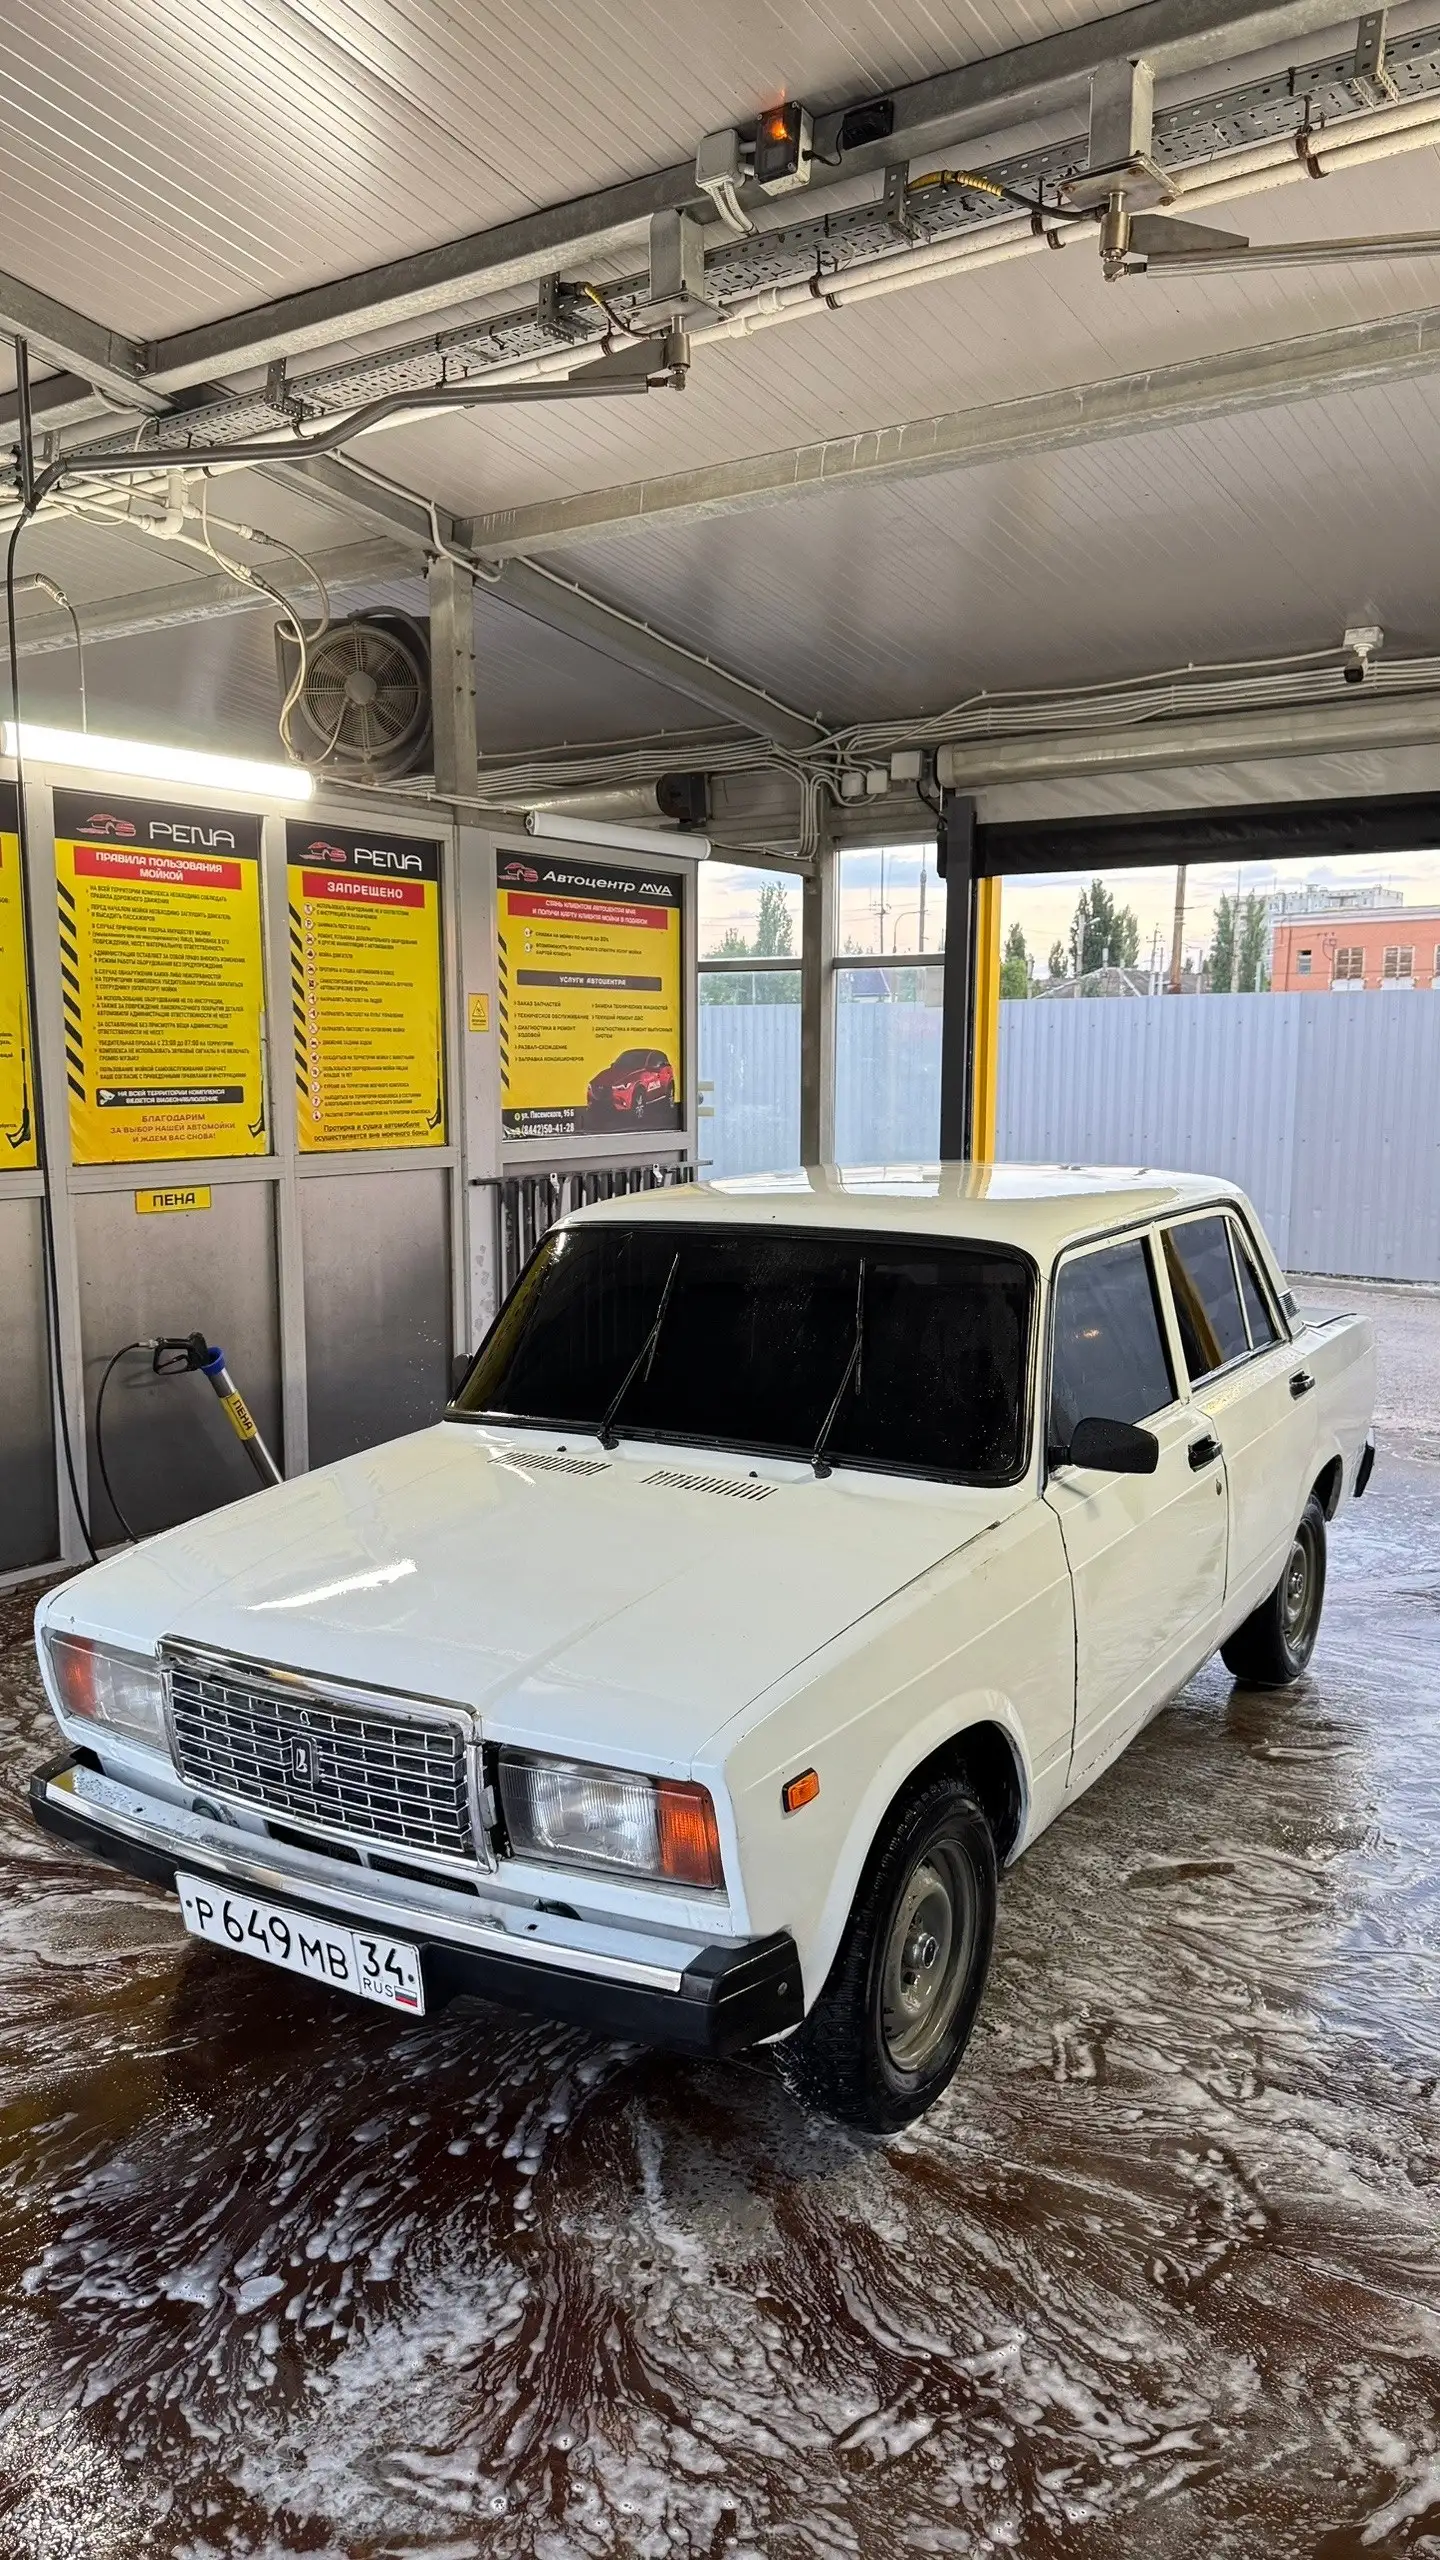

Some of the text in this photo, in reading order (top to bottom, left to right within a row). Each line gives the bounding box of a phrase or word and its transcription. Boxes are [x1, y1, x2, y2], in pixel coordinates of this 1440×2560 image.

[150, 822, 235, 848] PENA
[95, 851, 222, 873] ПРАВИЛА ПОЛЬЗОВАНИЯ
[354, 848, 422, 872] PENA
[139, 867, 183, 880] МОЙКОЙ
[327, 882, 403, 898] ЗАПРЕЩЕНО
[542, 870, 673, 897] Автоцентр MVA
[586, 977, 625, 985] АВТОЦЕНТРА
[141, 1113, 205, 1122] БЛАГОДАРИМ
[110, 1121, 235, 1134] ЗА ВЫБОР НАШЕЙ АВТОМОЙКИ
[324, 1123, 355, 1132] Протирка
[362, 1122, 382, 1130] сушка
[384, 1120, 419, 1129] автомобиля
[522, 1122, 574, 1136] (8442)50-41-28
[140, 1134, 166, 1142] ЖДЕМ
[168, 1133, 184, 1141] ВАС
[186, 1132, 216, 1140] СНОВА!
[313, 1132, 366, 1142] осуществляется
[368, 1131, 379, 1139] вне
[381, 1130, 410, 1138] моечного
[152, 1192, 196, 1206] ПЕНА
[232, 1399, 252, 1431] ПЕНА
[360, 1940, 404, 1986] 34
[363, 1978, 394, 1998] RUS
